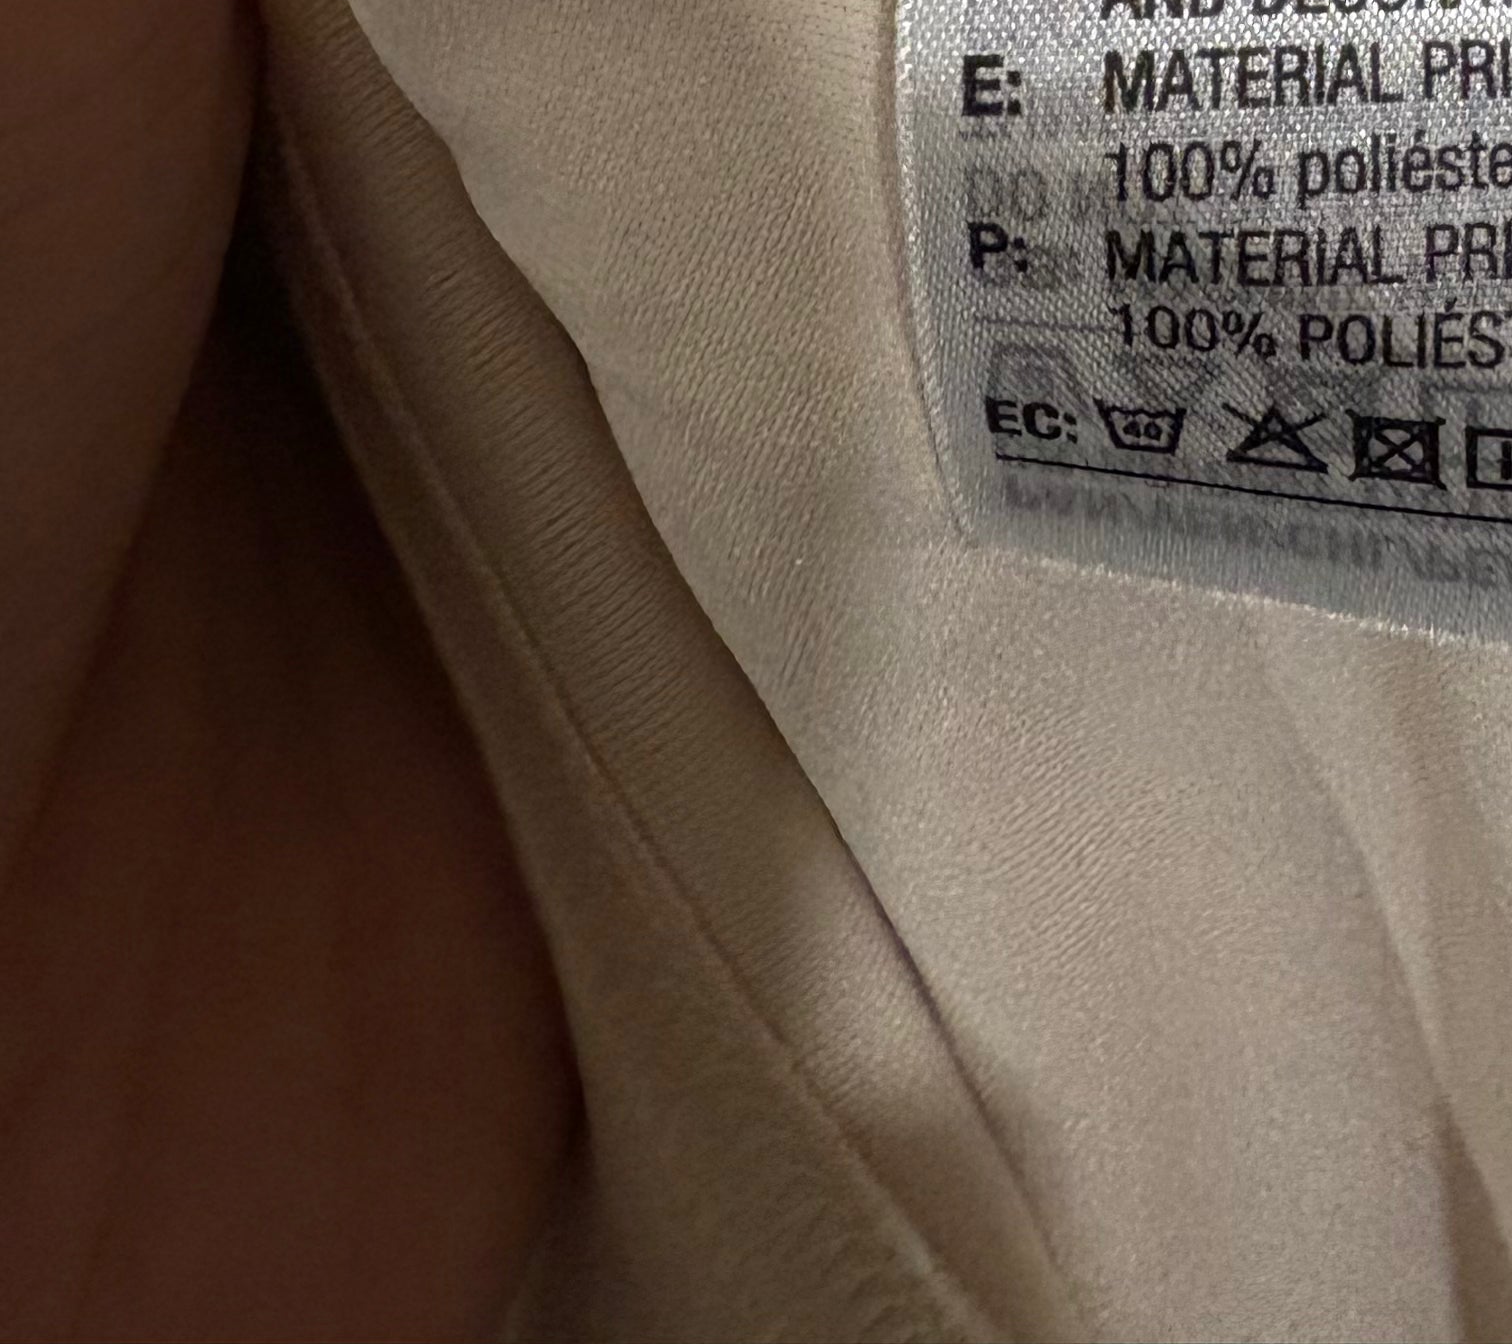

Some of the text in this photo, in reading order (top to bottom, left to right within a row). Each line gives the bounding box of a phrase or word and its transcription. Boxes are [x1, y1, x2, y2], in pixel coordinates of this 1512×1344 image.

[963, 54, 1022, 116] E:
[1102, 42, 1402, 112] MATERIAL
[1105, 139, 1275, 204] 100%
[969, 221, 1029, 272] P:
[1105, 225, 1402, 289] MATERIAL
[1109, 306, 1276, 357] 100%
[985, 398, 1077, 444] EC:
